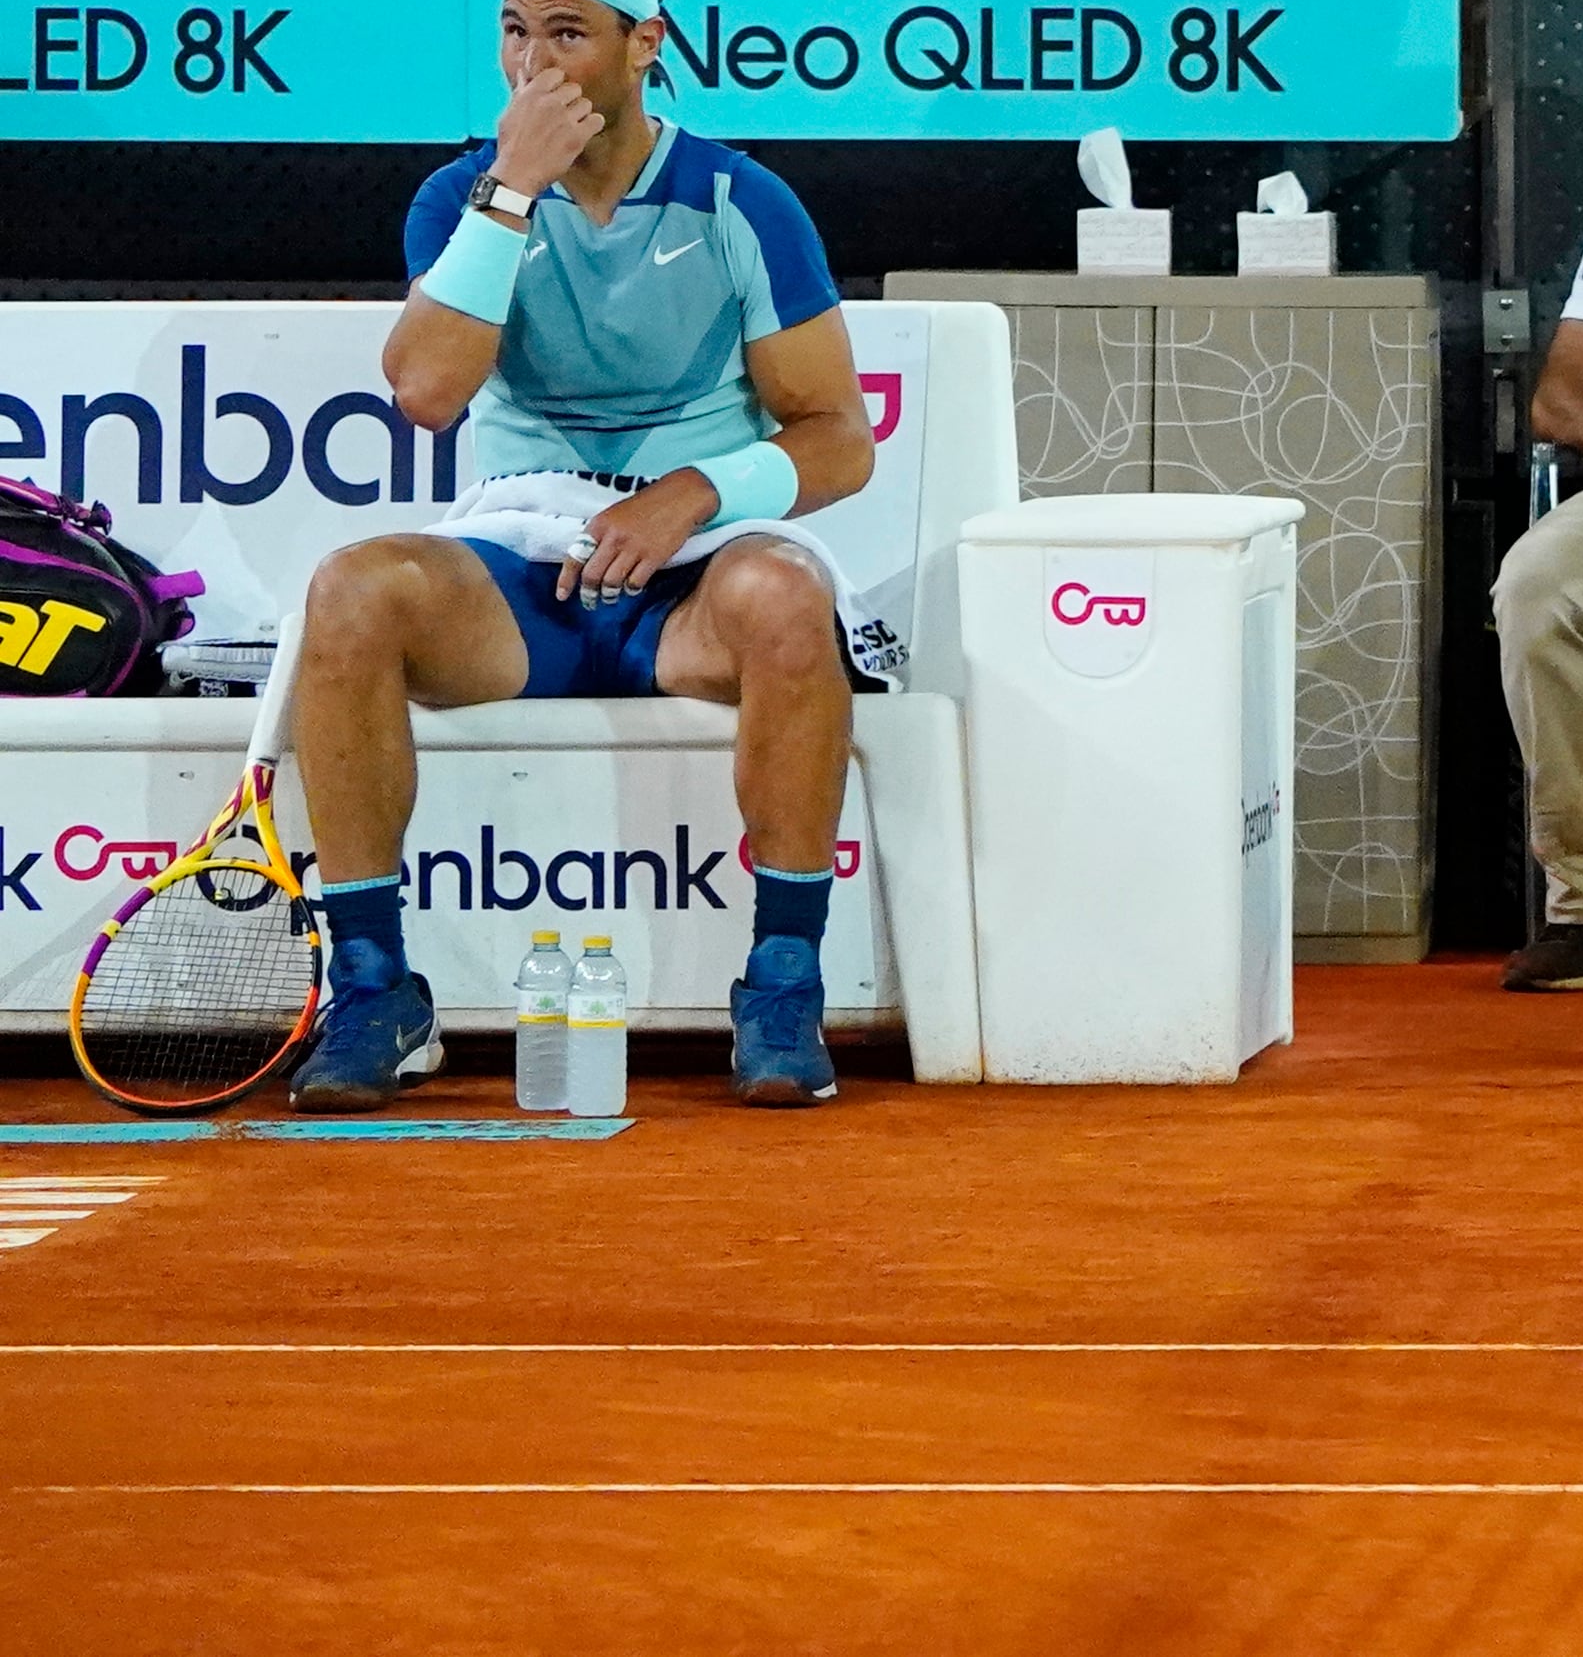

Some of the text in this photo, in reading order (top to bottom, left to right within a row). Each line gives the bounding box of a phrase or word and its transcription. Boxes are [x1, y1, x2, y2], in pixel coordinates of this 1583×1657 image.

[173, 7, 292, 93] 8K
[650, 5, 1285, 93] Neo QLED 8K
[195, 824, 728, 935] Onbank
